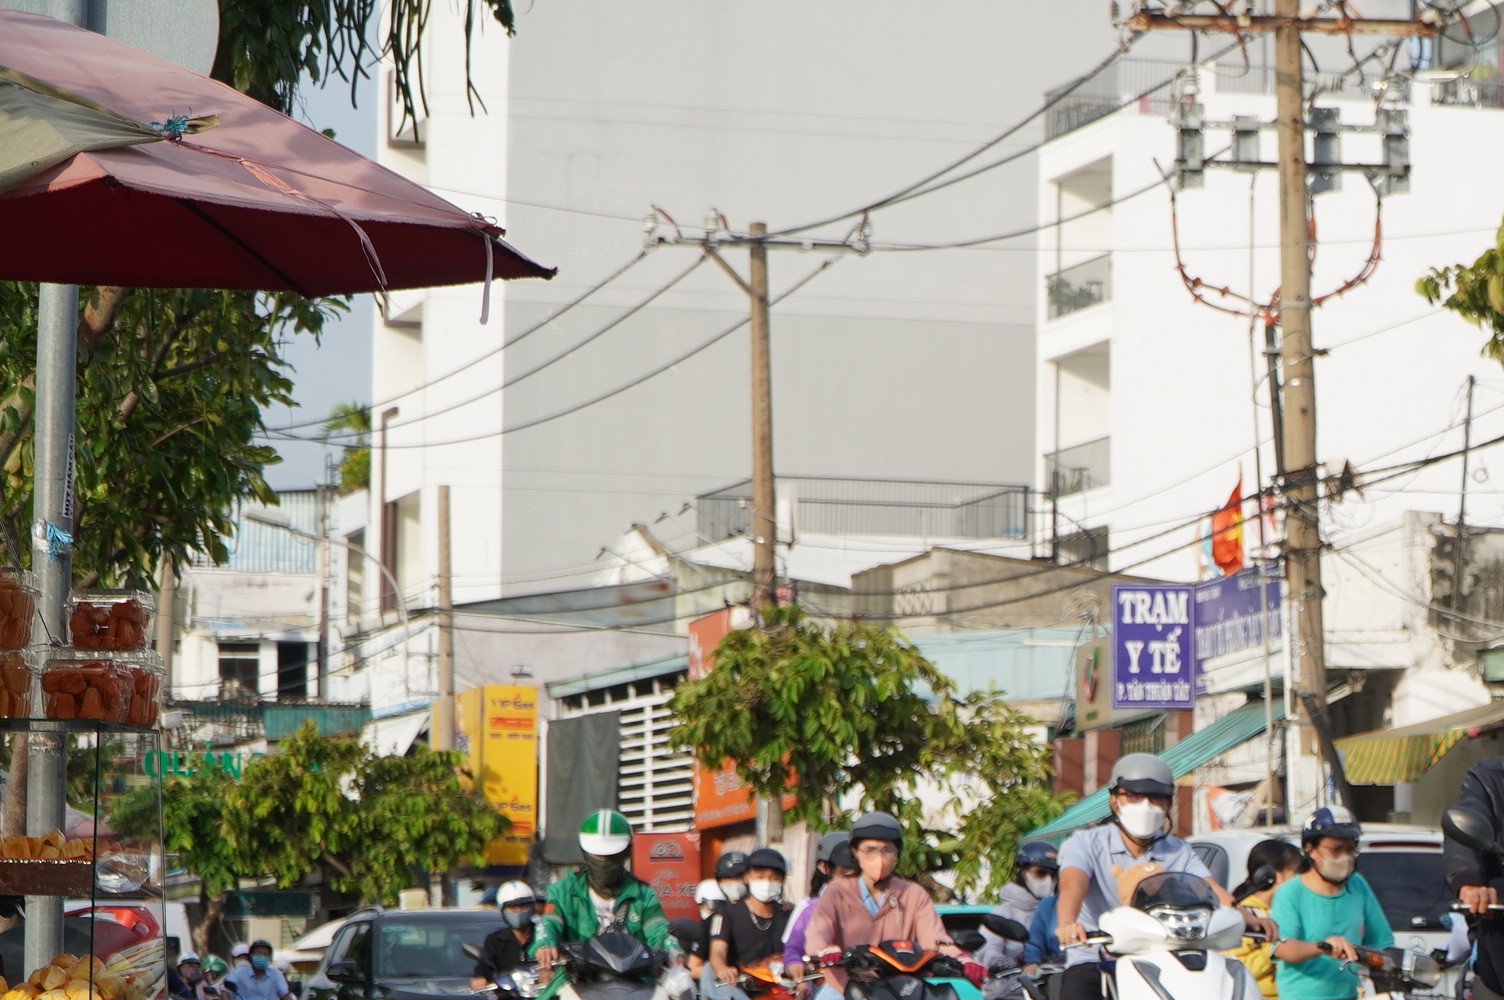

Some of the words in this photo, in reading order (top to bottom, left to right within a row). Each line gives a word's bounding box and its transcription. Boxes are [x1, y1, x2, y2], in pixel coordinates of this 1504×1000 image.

[1119, 591, 1189, 632] TRẠM
[1125, 640, 1145, 673] Y
[1148, 626, 1181, 673] TẾ
